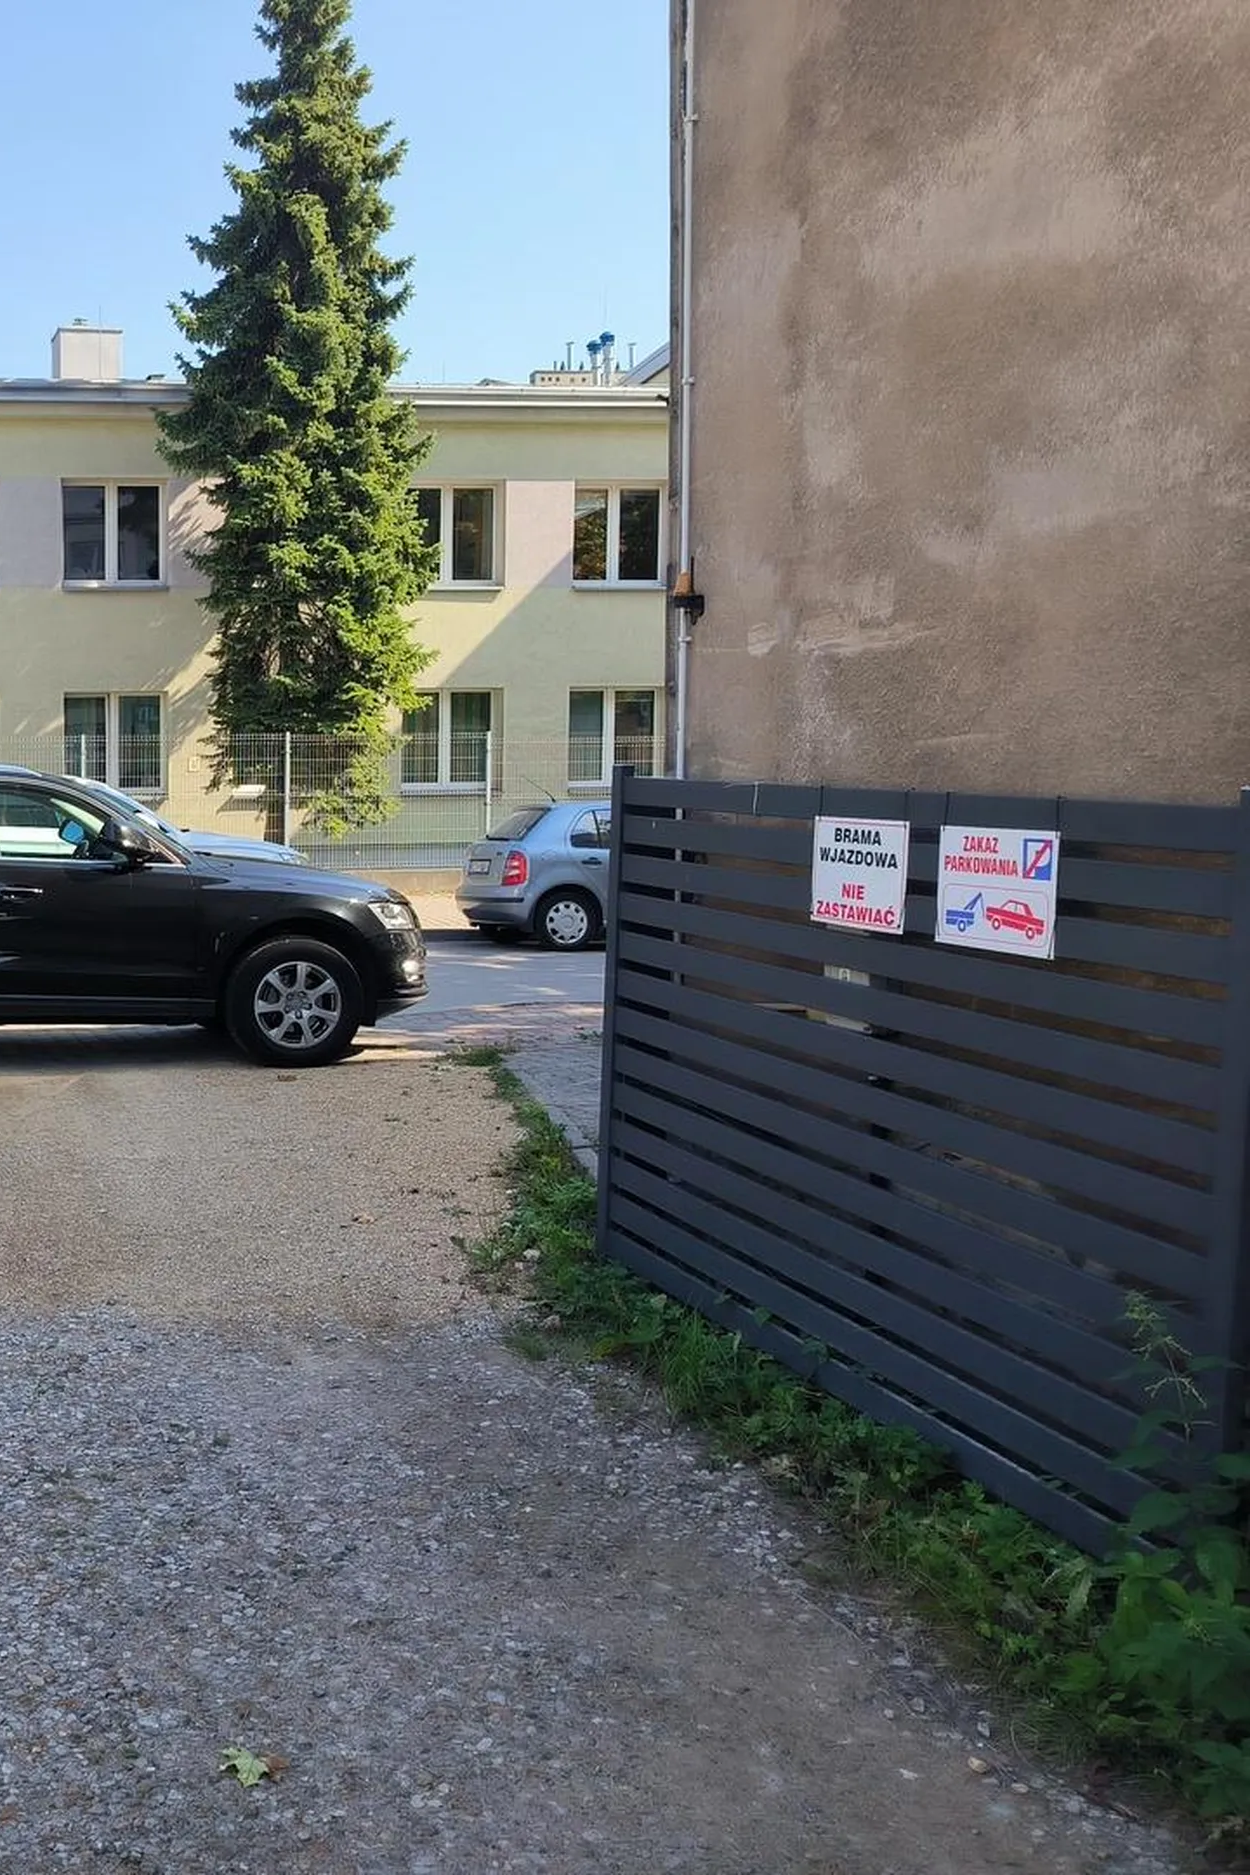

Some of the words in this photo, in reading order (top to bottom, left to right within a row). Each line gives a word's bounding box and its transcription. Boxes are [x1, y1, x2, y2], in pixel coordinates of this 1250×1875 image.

[834, 827, 881, 846] BRAMA
[963, 836, 999, 853] ZAKAZ
[820, 847, 898, 869] WJAZDOWA
[944, 855, 1019, 877] PARKOWANIA
[842, 884, 865, 900] NIE
[817, 901, 895, 925] ZASTAWIAĆ
